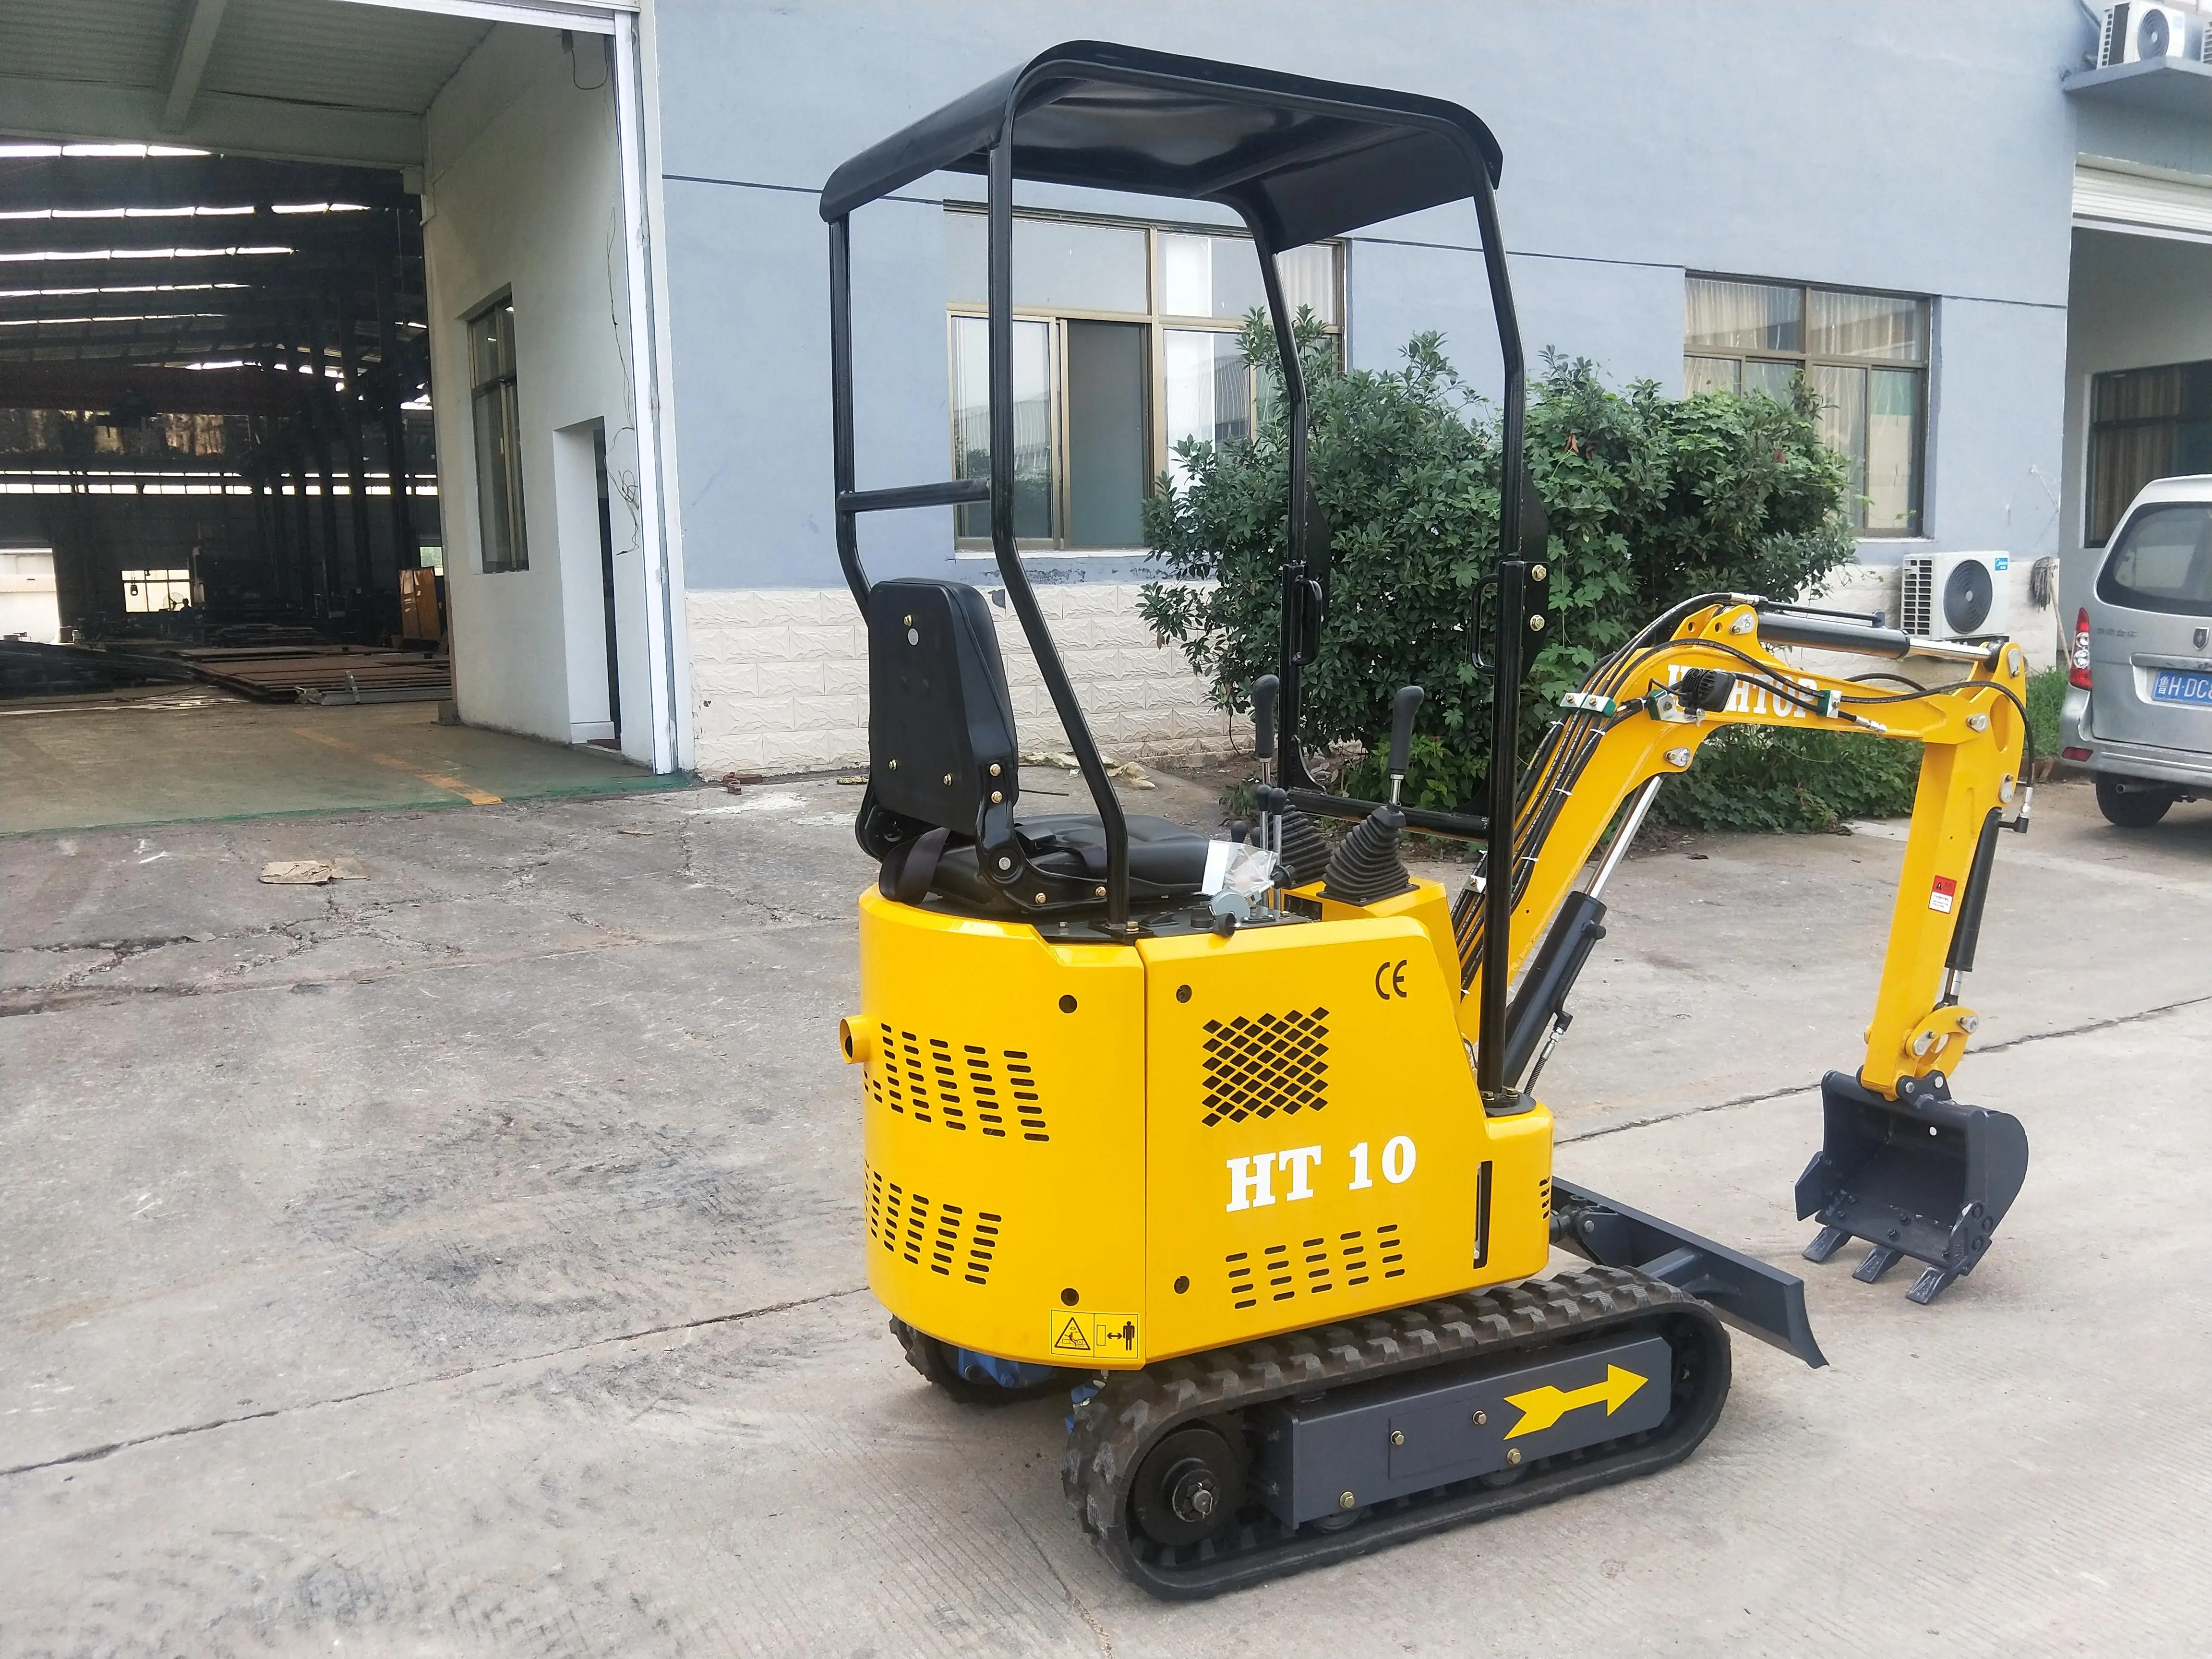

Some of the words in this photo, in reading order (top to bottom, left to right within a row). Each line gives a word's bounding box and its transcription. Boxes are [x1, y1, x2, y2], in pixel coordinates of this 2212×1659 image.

[1375, 959, 1407, 1000] CE
[1225, 1144, 1322, 1213] HT
[1348, 1135, 1417, 1191] 10
